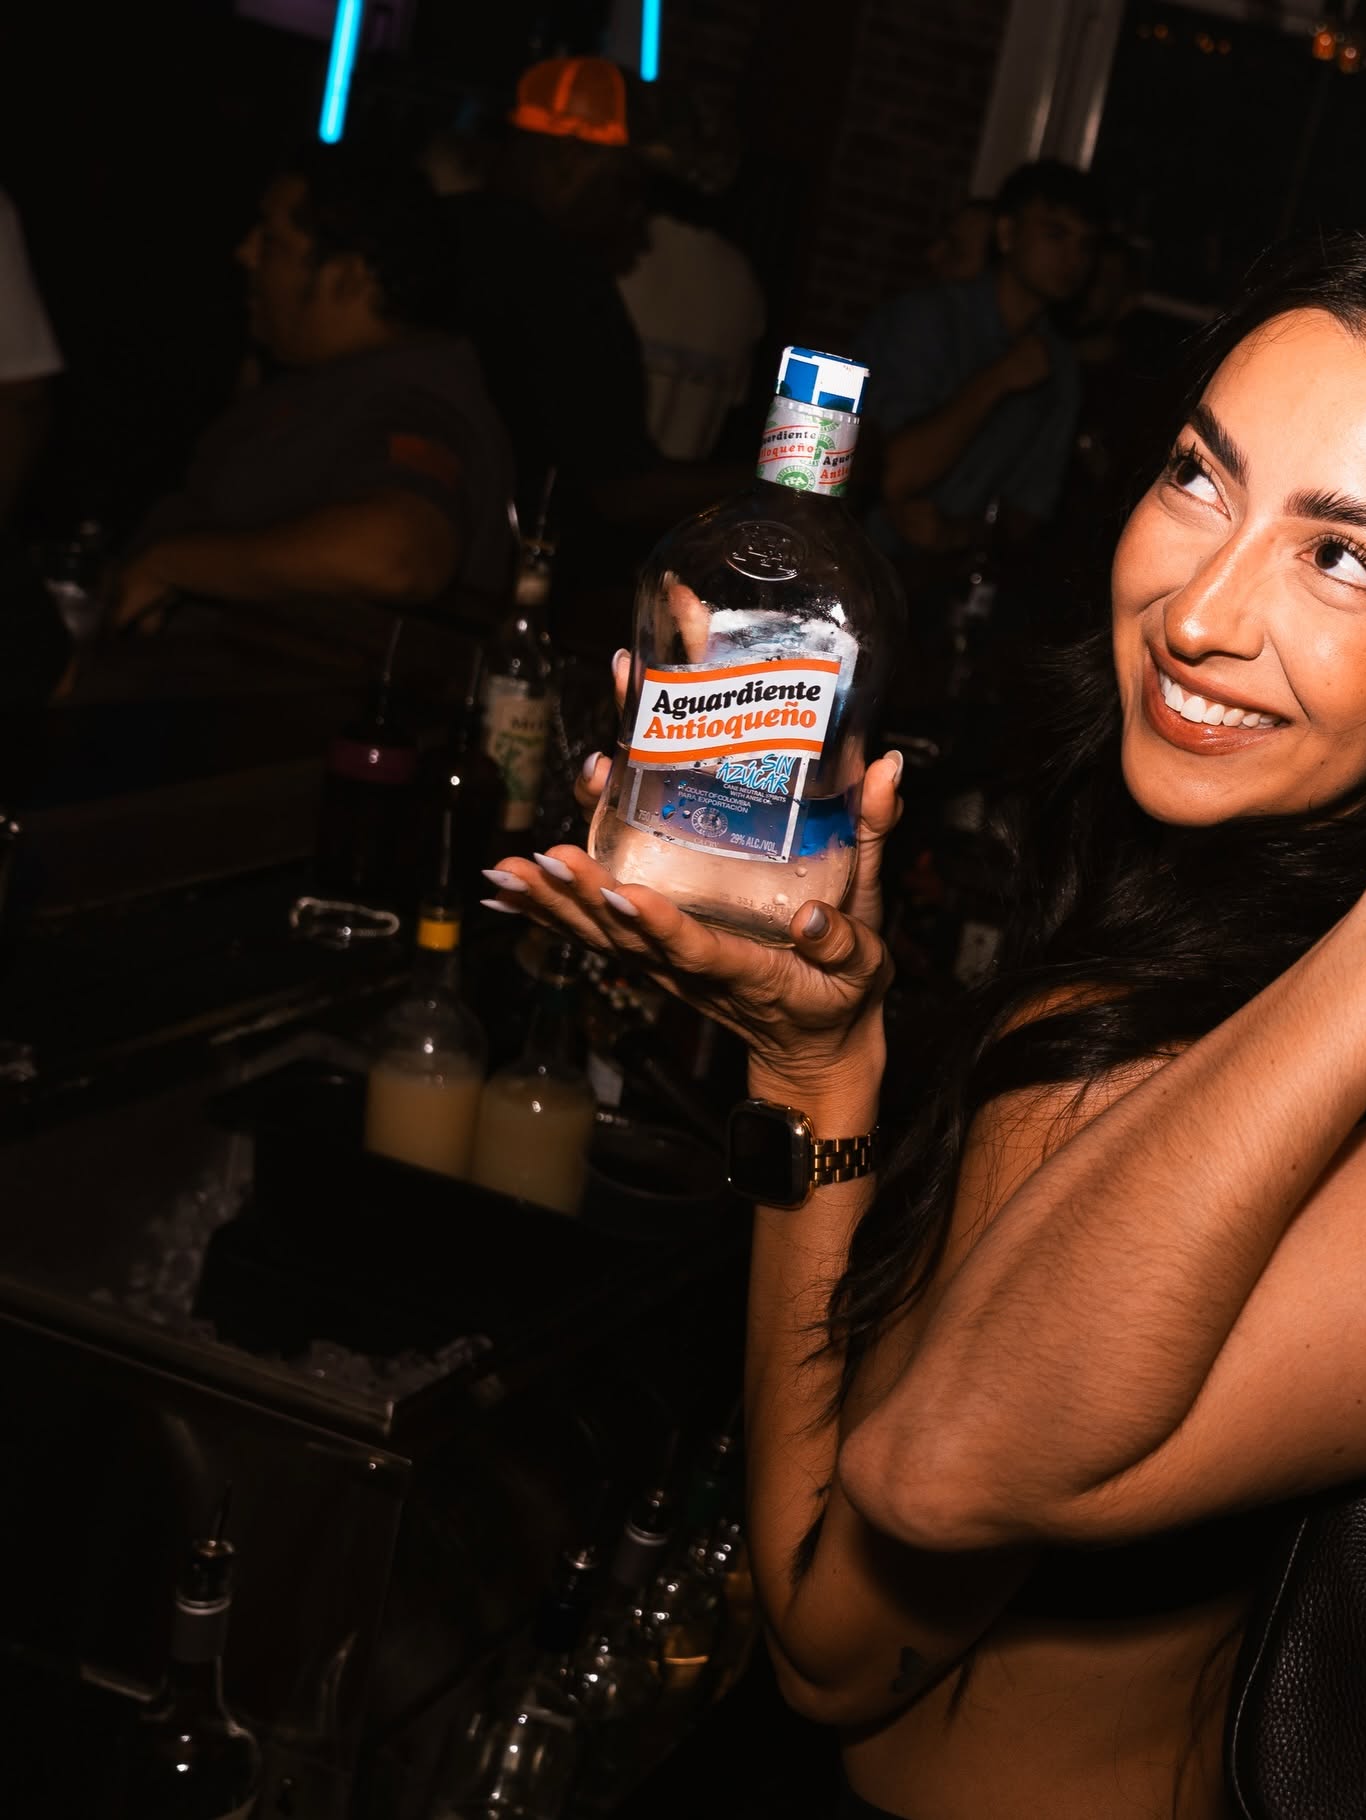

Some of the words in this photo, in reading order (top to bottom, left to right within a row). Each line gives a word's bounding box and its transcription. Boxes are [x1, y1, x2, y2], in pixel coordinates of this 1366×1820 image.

[763, 430, 817, 443] ardiente
[652, 680, 821, 719] Aguardiente
[643, 702, 817, 739] Antioqueño
[761, 754, 796, 776] SIN
[716, 760, 791, 795] AZÚCAR
[678, 791, 697, 801] PARA
[678, 785, 708, 796] ODUCT
[717, 795, 751, 808] COLOMBIA
[730, 832, 746, 845] 29%
